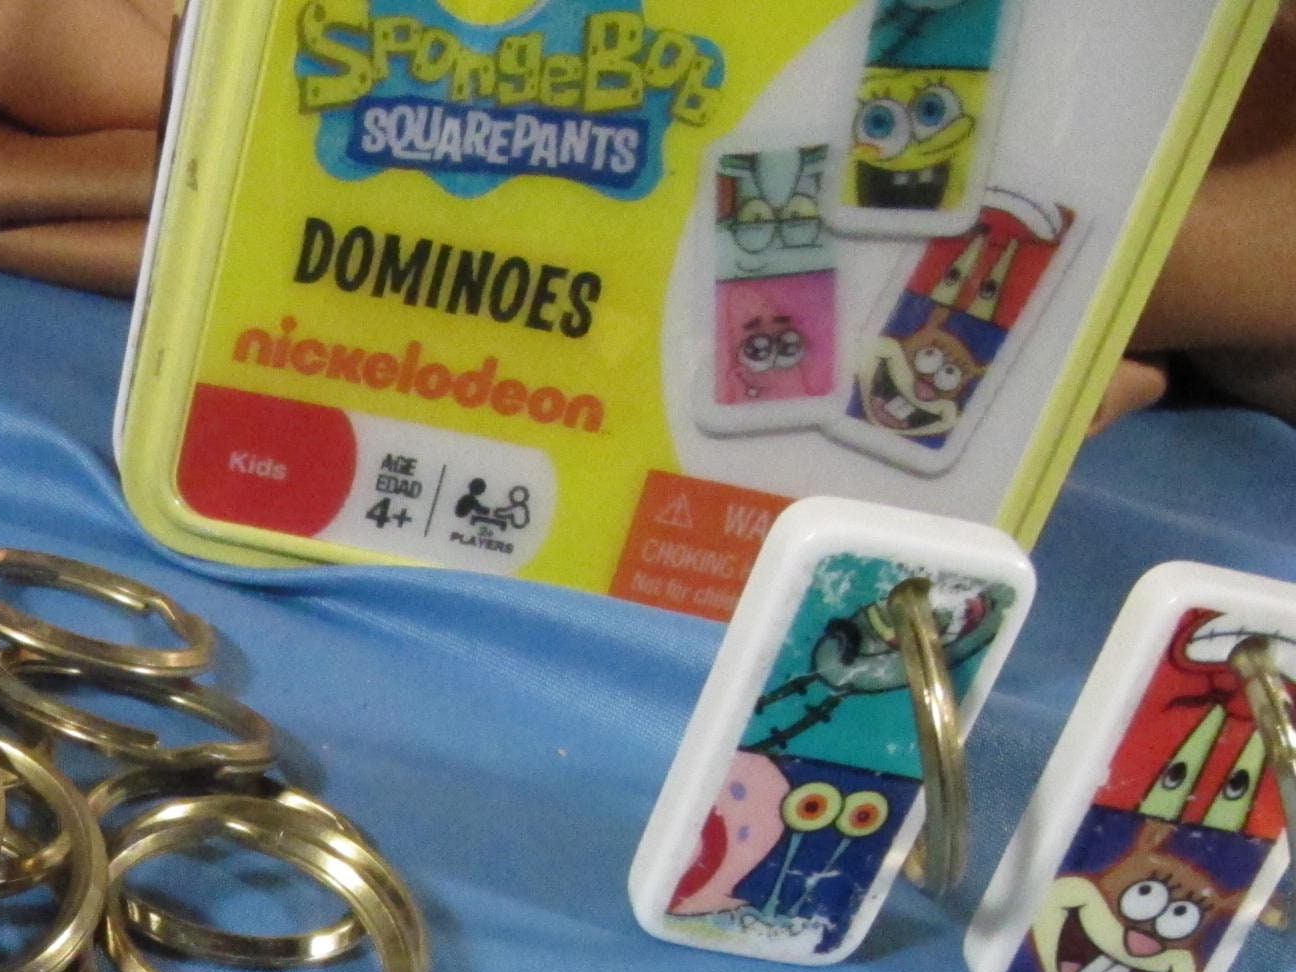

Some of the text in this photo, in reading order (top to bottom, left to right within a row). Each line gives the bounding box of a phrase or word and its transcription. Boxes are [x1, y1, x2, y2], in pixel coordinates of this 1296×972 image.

[362, 106, 641, 174] SQUAREPANTS
[293, 217, 603, 338] DOMINOES
[233, 315, 605, 432] nickelodeon
[229, 451, 287, 480] Kids
[381, 454, 417, 476] AGE
[375, 475, 422, 499] EDAD
[366, 497, 412, 528] 4+
[450, 532, 514, 553] PLAYERS
